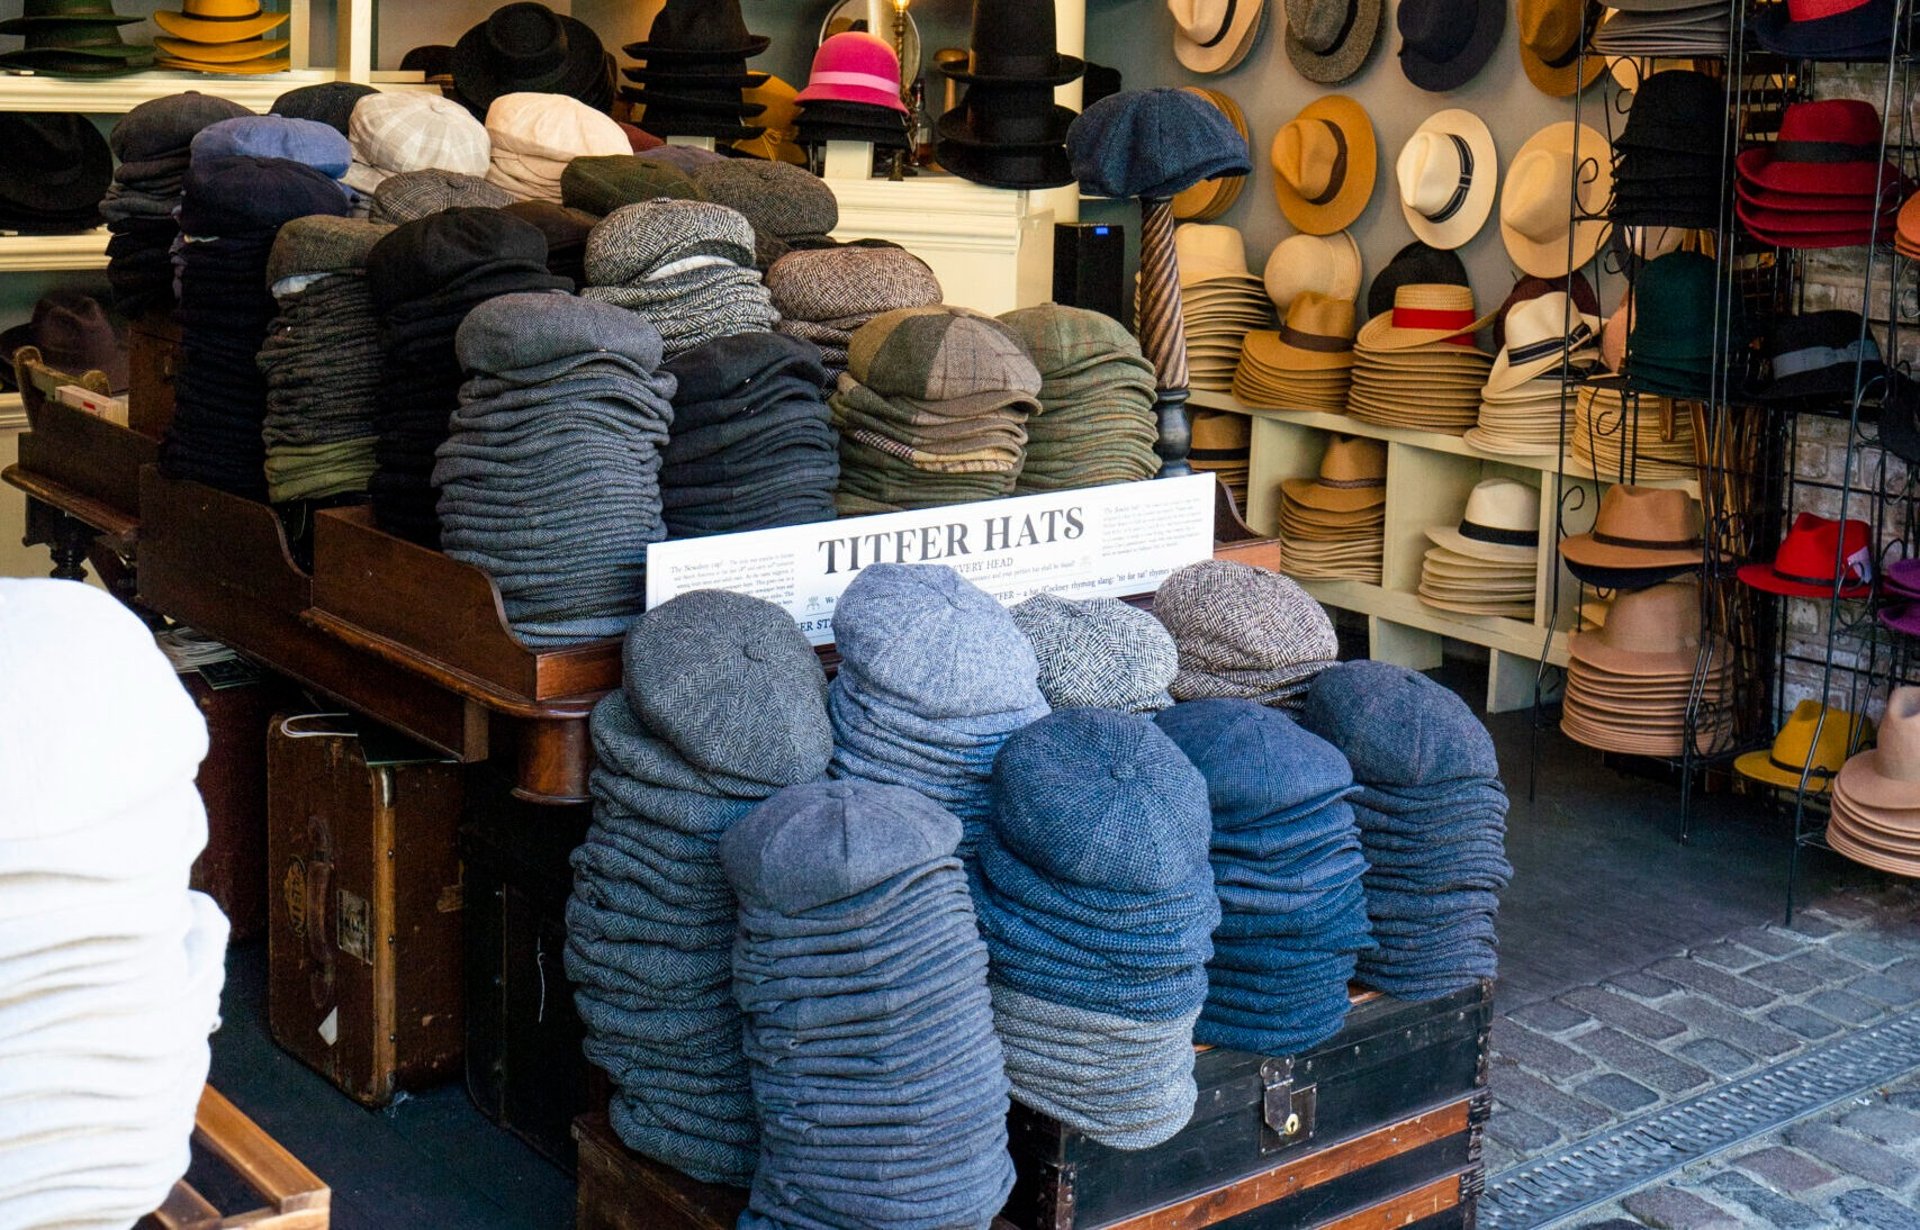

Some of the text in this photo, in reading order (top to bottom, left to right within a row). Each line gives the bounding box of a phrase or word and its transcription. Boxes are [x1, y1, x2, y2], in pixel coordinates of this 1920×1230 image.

[818, 522, 972, 575] TITFER
[983, 507, 1085, 552] HATS
[986, 557, 1014, 570] HEAD
